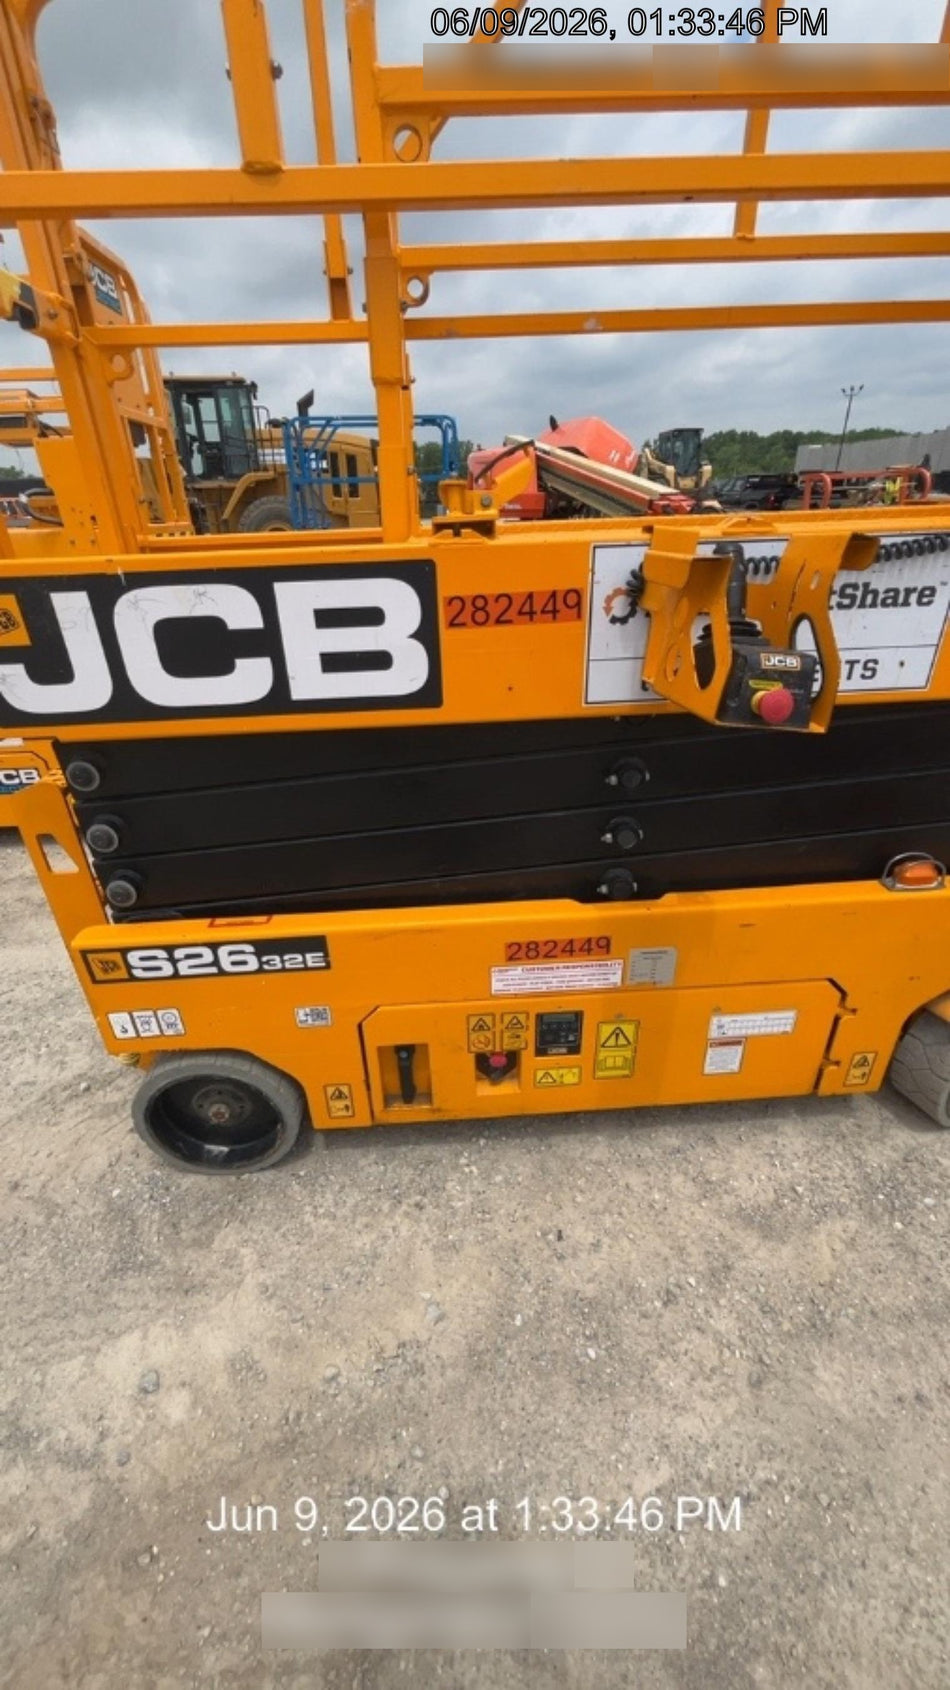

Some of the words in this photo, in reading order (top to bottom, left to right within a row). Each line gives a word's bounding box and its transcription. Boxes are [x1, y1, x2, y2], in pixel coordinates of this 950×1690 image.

[447, 588, 582, 627] 282449
[0, 577, 429, 714] JCB
[765, 655, 798, 667] JCB
[0, 769, 40, 784] CB
[126, 943, 259, 979] S26
[261, 952, 327, 970] 32E
[507, 936, 611, 960] 282449
